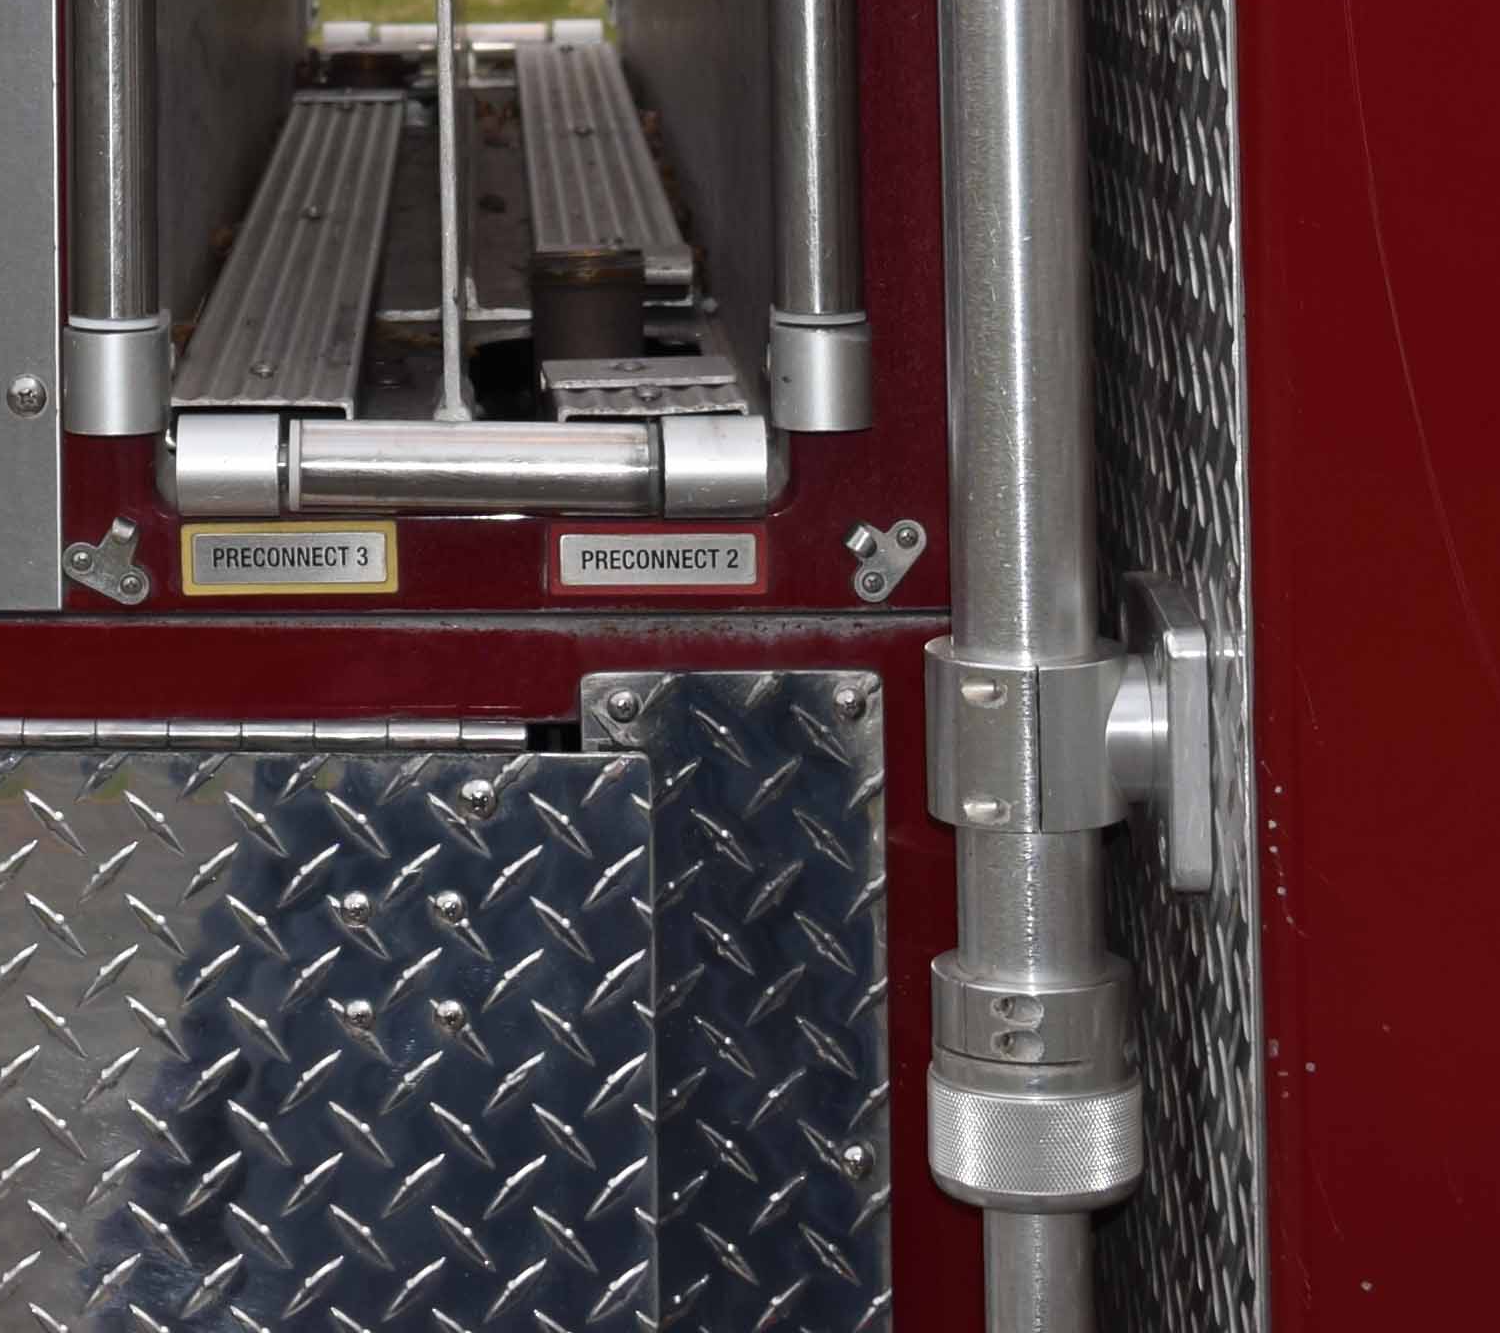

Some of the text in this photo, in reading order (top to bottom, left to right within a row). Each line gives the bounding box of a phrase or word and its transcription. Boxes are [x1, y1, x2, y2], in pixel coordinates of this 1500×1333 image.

[212, 546, 369, 568] PRECONNECT 3
[581, 548, 739, 570] PRECONNECT 2
